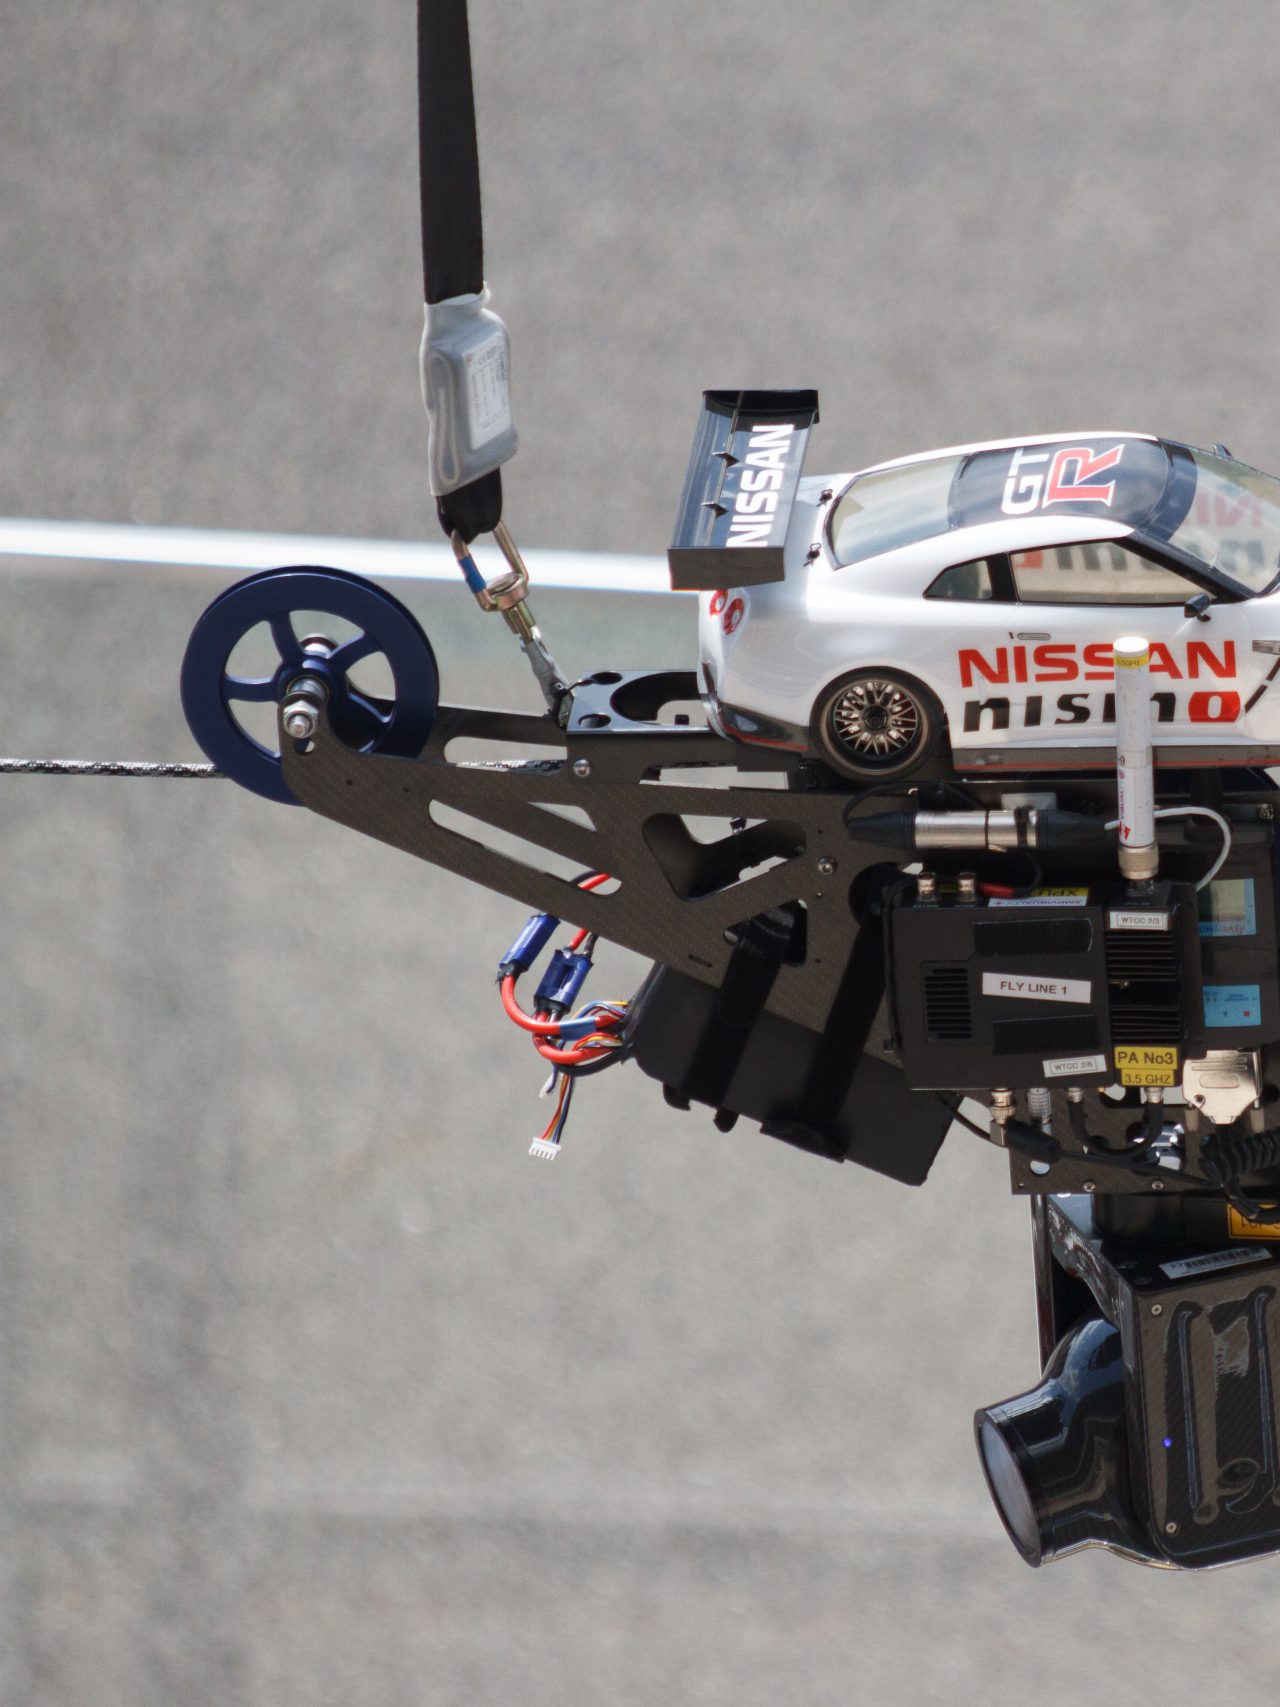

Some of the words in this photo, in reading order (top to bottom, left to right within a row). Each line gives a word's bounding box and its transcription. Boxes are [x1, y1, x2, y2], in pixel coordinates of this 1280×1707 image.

[726, 424, 795, 547] NISSAN
[1001, 448, 1051, 515] GT
[1042, 443, 1125, 508] R
[958, 640, 1236, 688] NISSAN
[1000, 981, 1025, 991] FLY
[1028, 983, 1057, 994] LINE
[1060, 985, 1067, 995] 1
[1117, 1051, 1139, 1064] PA
[1143, 1051, 1174, 1065] No3
[1055, 1062, 1079, 1071] WTCC
[1124, 1074, 1142, 1084] 3.5
[1145, 1074, 1171, 1085] GHZ
